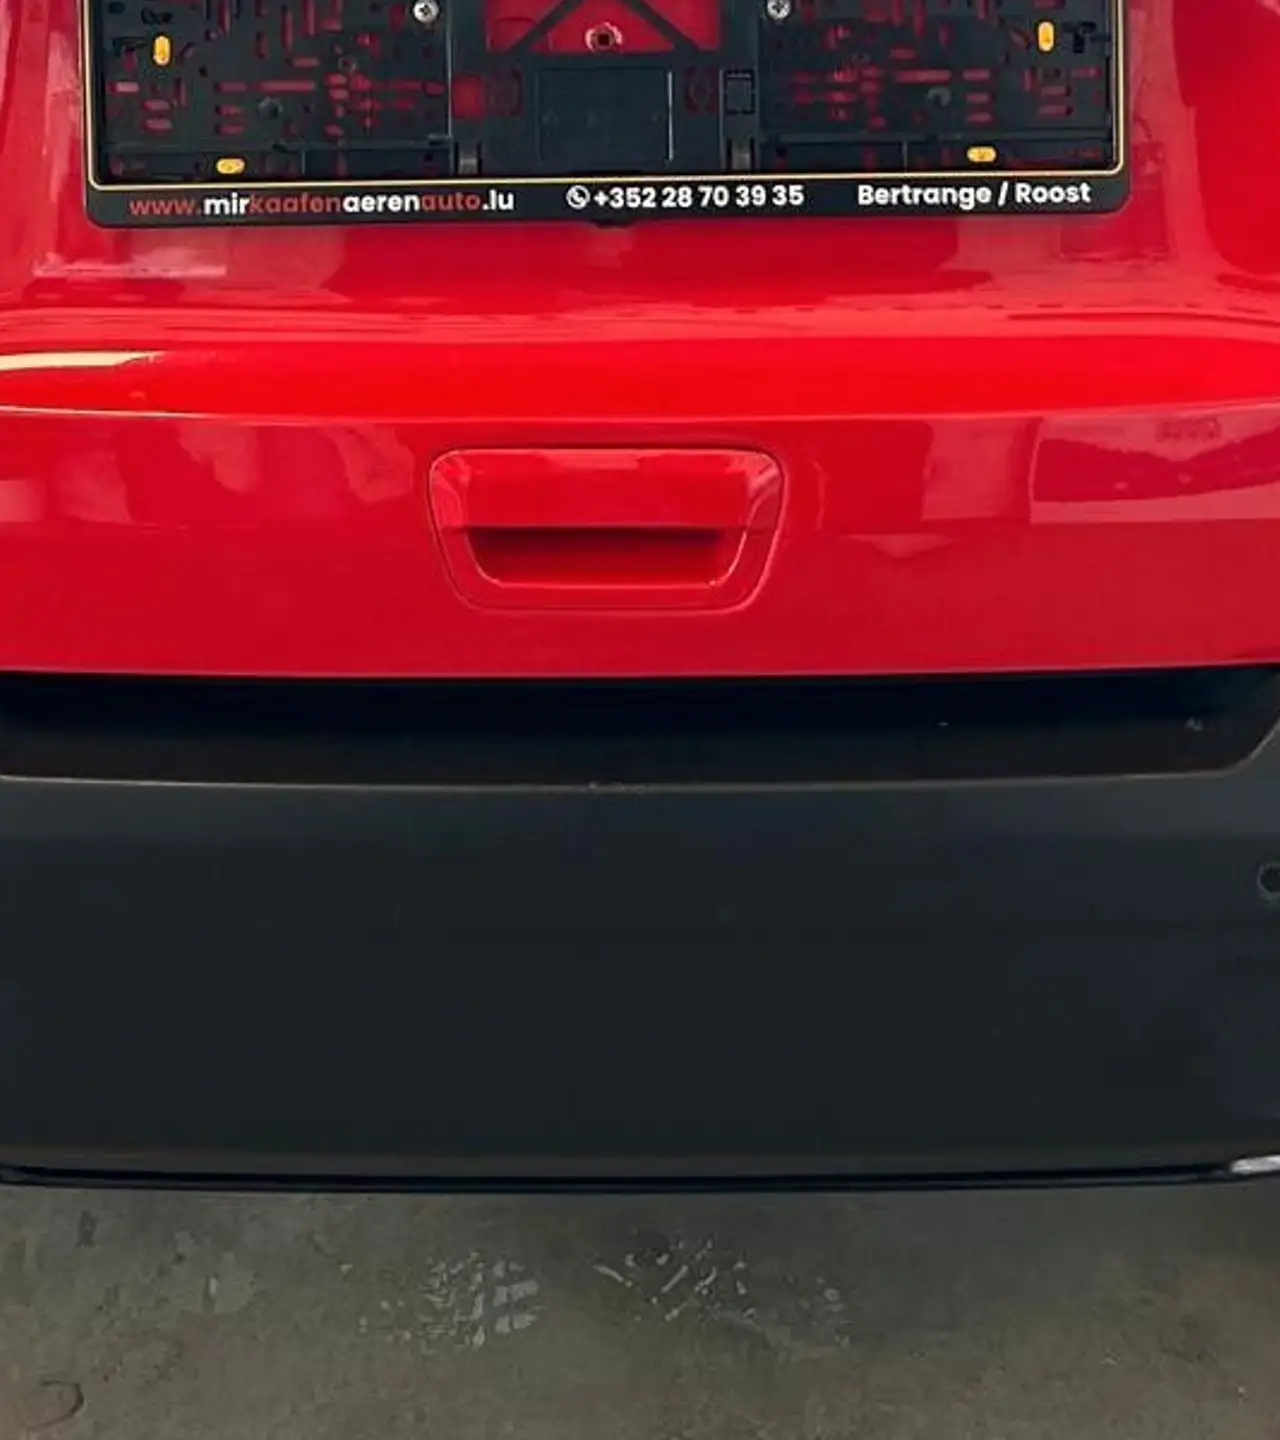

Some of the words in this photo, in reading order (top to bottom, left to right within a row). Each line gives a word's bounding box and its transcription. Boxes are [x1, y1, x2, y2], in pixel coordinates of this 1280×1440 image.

[129, 189, 515, 217] www.mirkaafenaerenauto.lu
[593, 186, 656, 209] +352
[662, 185, 693, 208] 28
[698, 185, 729, 207] 70
[734, 185, 767, 207] 39
[772, 184, 805, 206] 35
[858, 183, 992, 211] Bertrange
[1015, 182, 1091, 205] Roost
